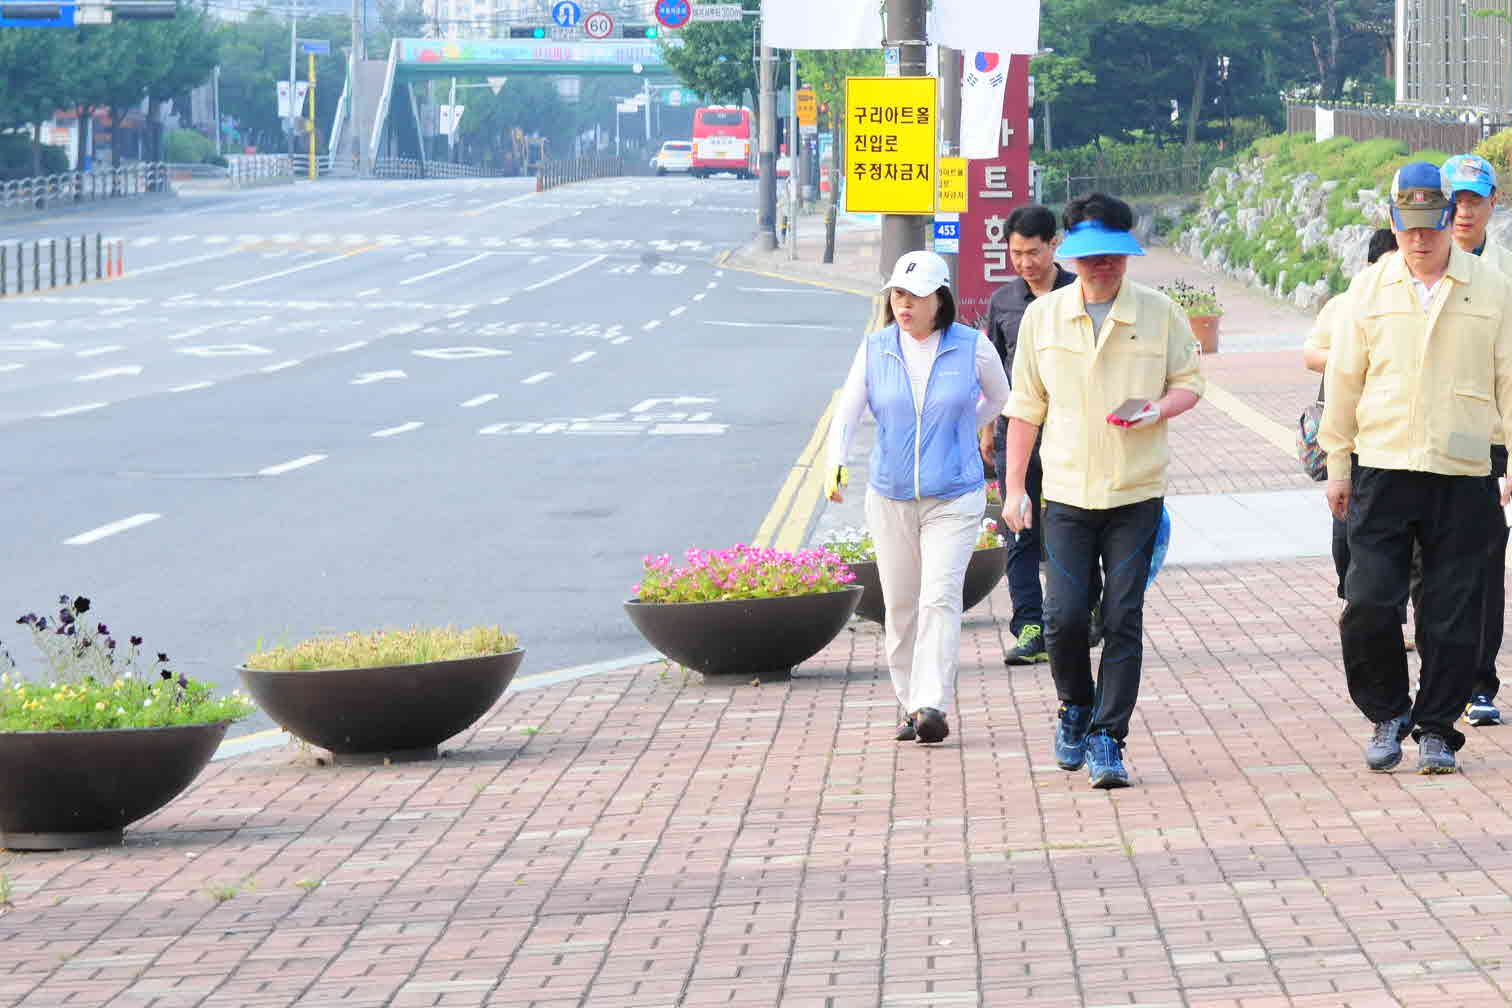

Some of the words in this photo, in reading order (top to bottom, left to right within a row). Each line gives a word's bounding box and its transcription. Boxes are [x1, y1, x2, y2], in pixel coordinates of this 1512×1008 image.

[589, 20, 608, 33] 60
[853, 106, 930, 125] 구리아트홀
[854, 134, 899, 153] 진입로
[937, 225, 957, 237] 453
